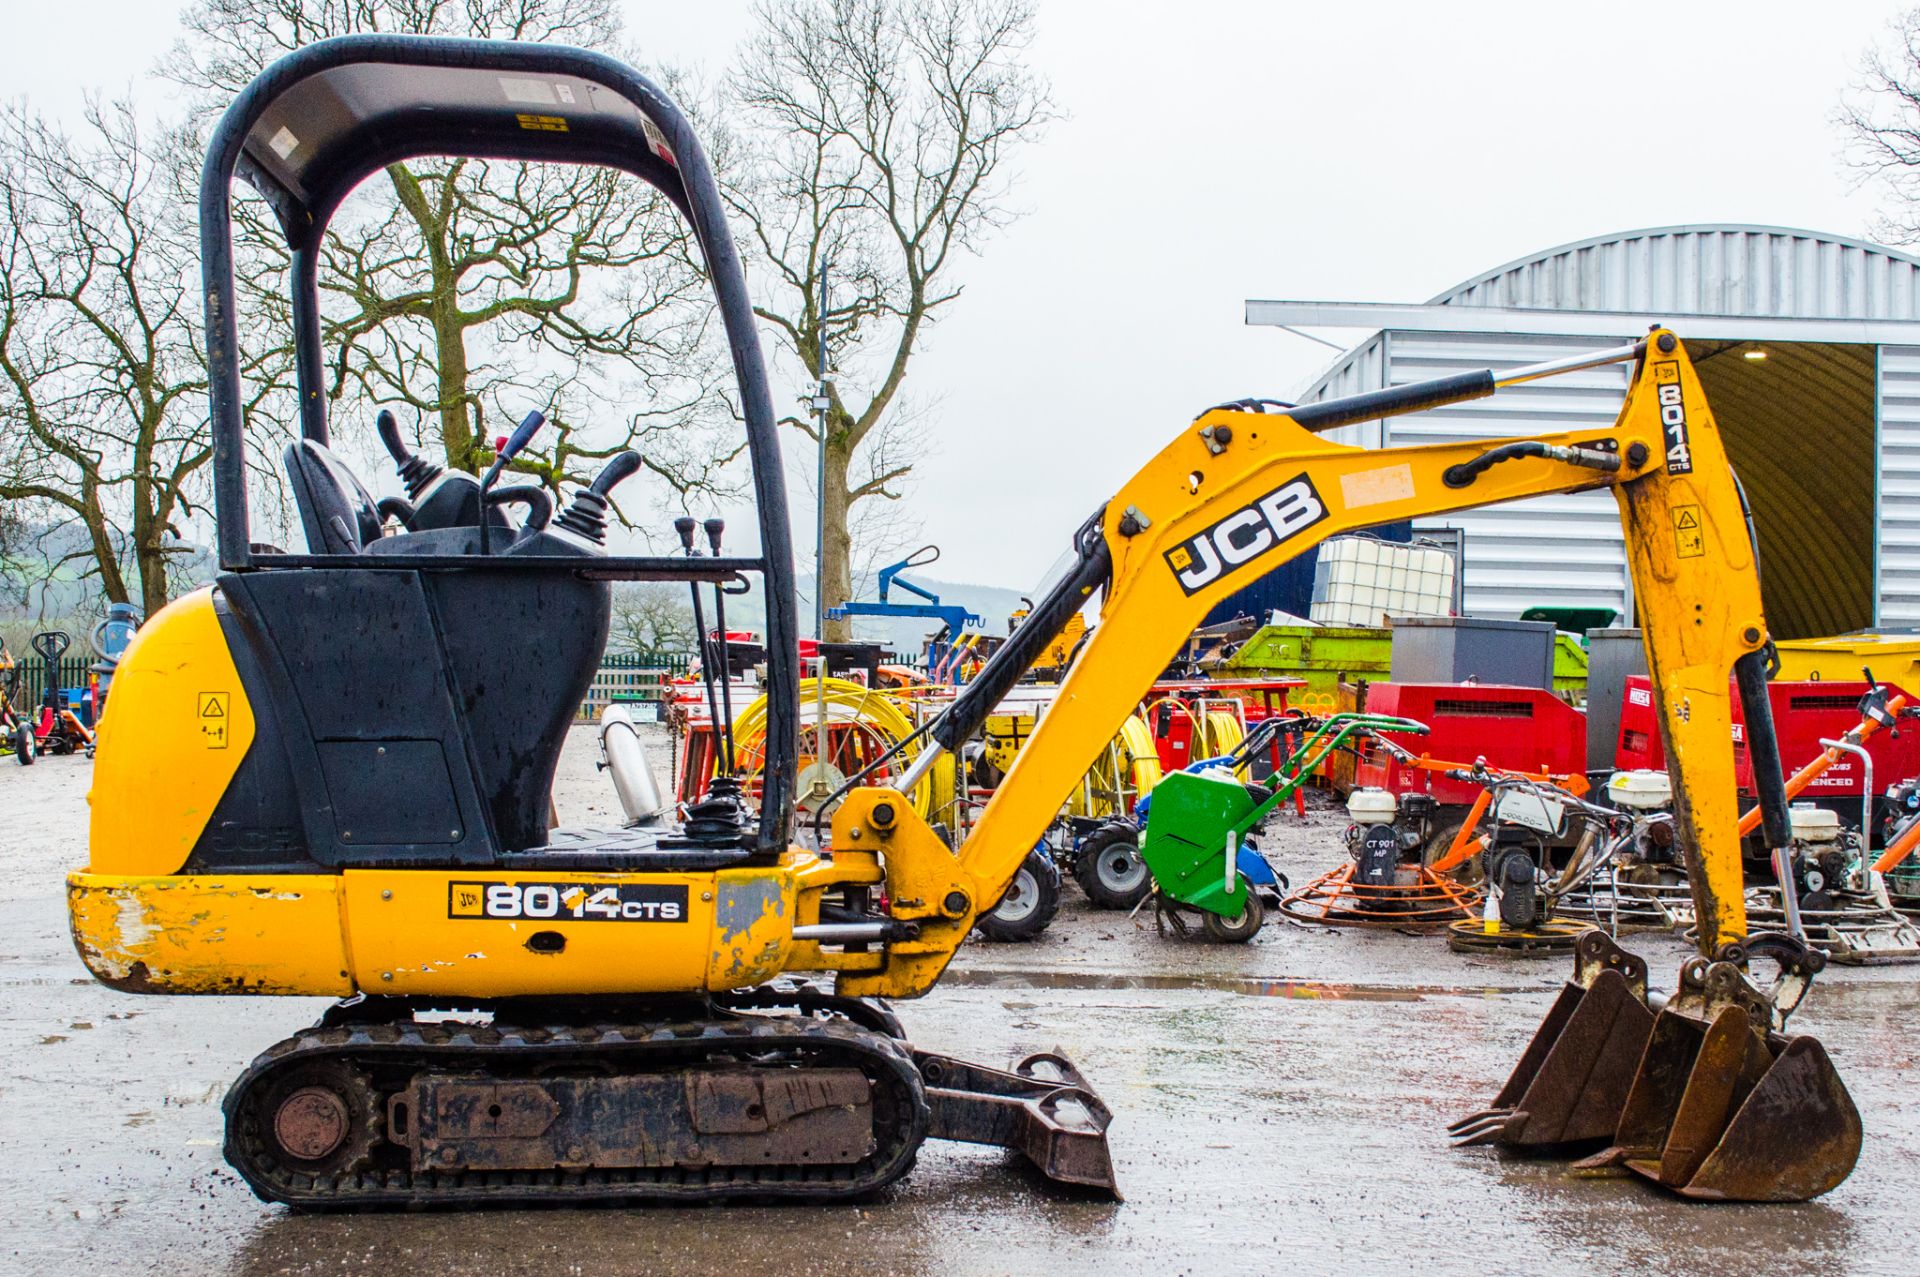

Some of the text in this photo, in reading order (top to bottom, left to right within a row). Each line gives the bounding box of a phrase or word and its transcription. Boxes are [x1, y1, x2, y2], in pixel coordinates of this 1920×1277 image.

[1659, 385, 1689, 462] 8014
[1669, 463, 1690, 471] CTS
[1180, 482, 1322, 589] JCB
[1366, 840, 1395, 849] CT 901
